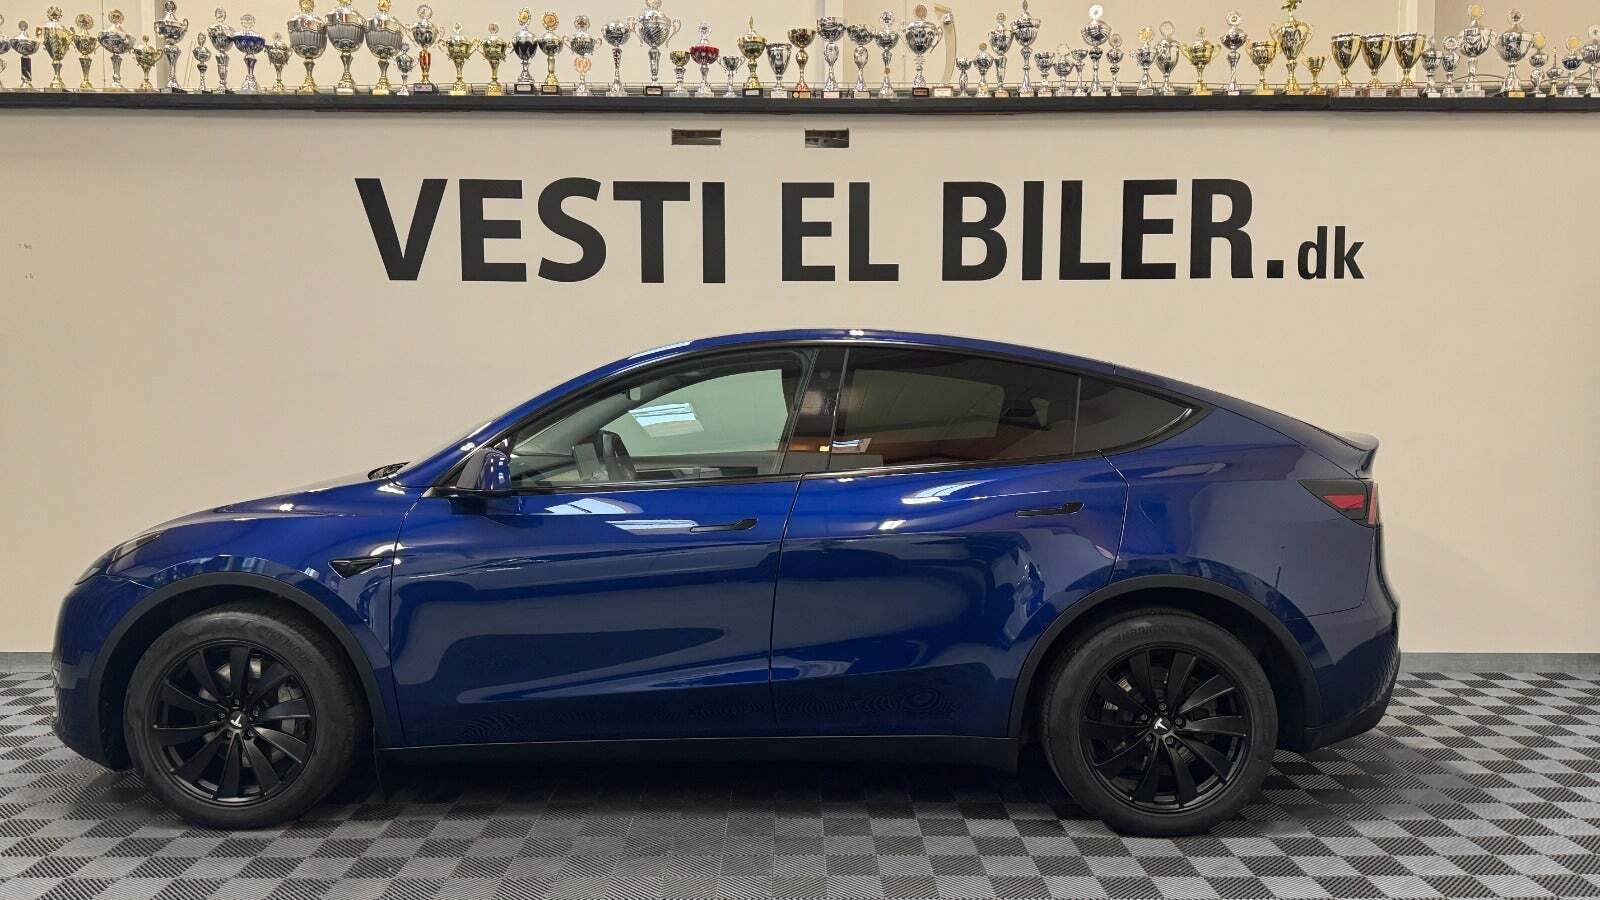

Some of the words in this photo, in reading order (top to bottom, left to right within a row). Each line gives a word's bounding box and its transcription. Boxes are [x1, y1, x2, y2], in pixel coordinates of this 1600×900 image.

[355, 178, 726, 283] VESTI
[781, 182, 899, 282] EL
[941, 178, 1365, 282] BILER.dk
